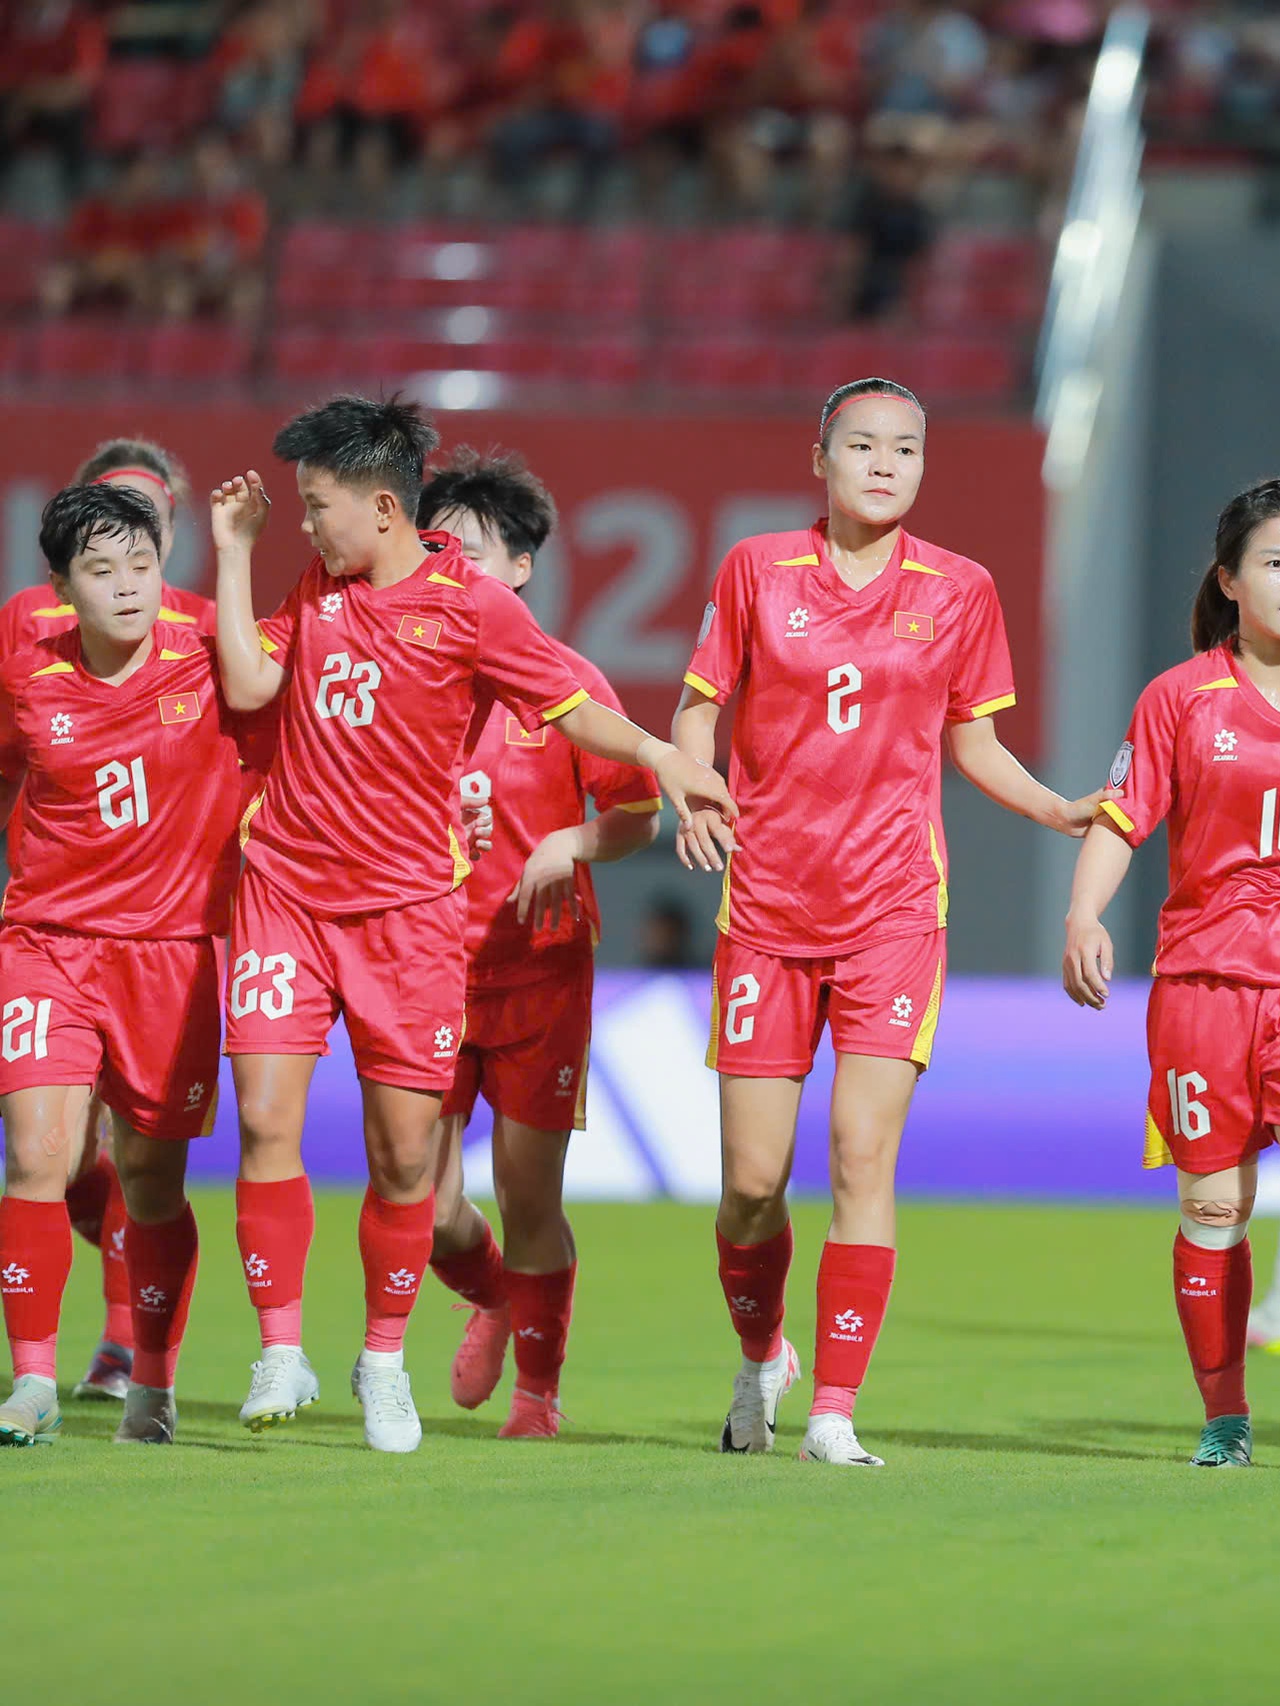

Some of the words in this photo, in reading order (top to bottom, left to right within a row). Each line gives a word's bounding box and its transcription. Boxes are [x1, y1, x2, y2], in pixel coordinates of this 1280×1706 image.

[314, 651, 382, 728] 23
[827, 661, 862, 735] 2
[94, 755, 149, 830] 21
[230, 948, 297, 1021] 23
[725, 973, 761, 1045] 2
[1, 995, 53, 1063] 21
[1166, 1068, 1211, 1141] 16
